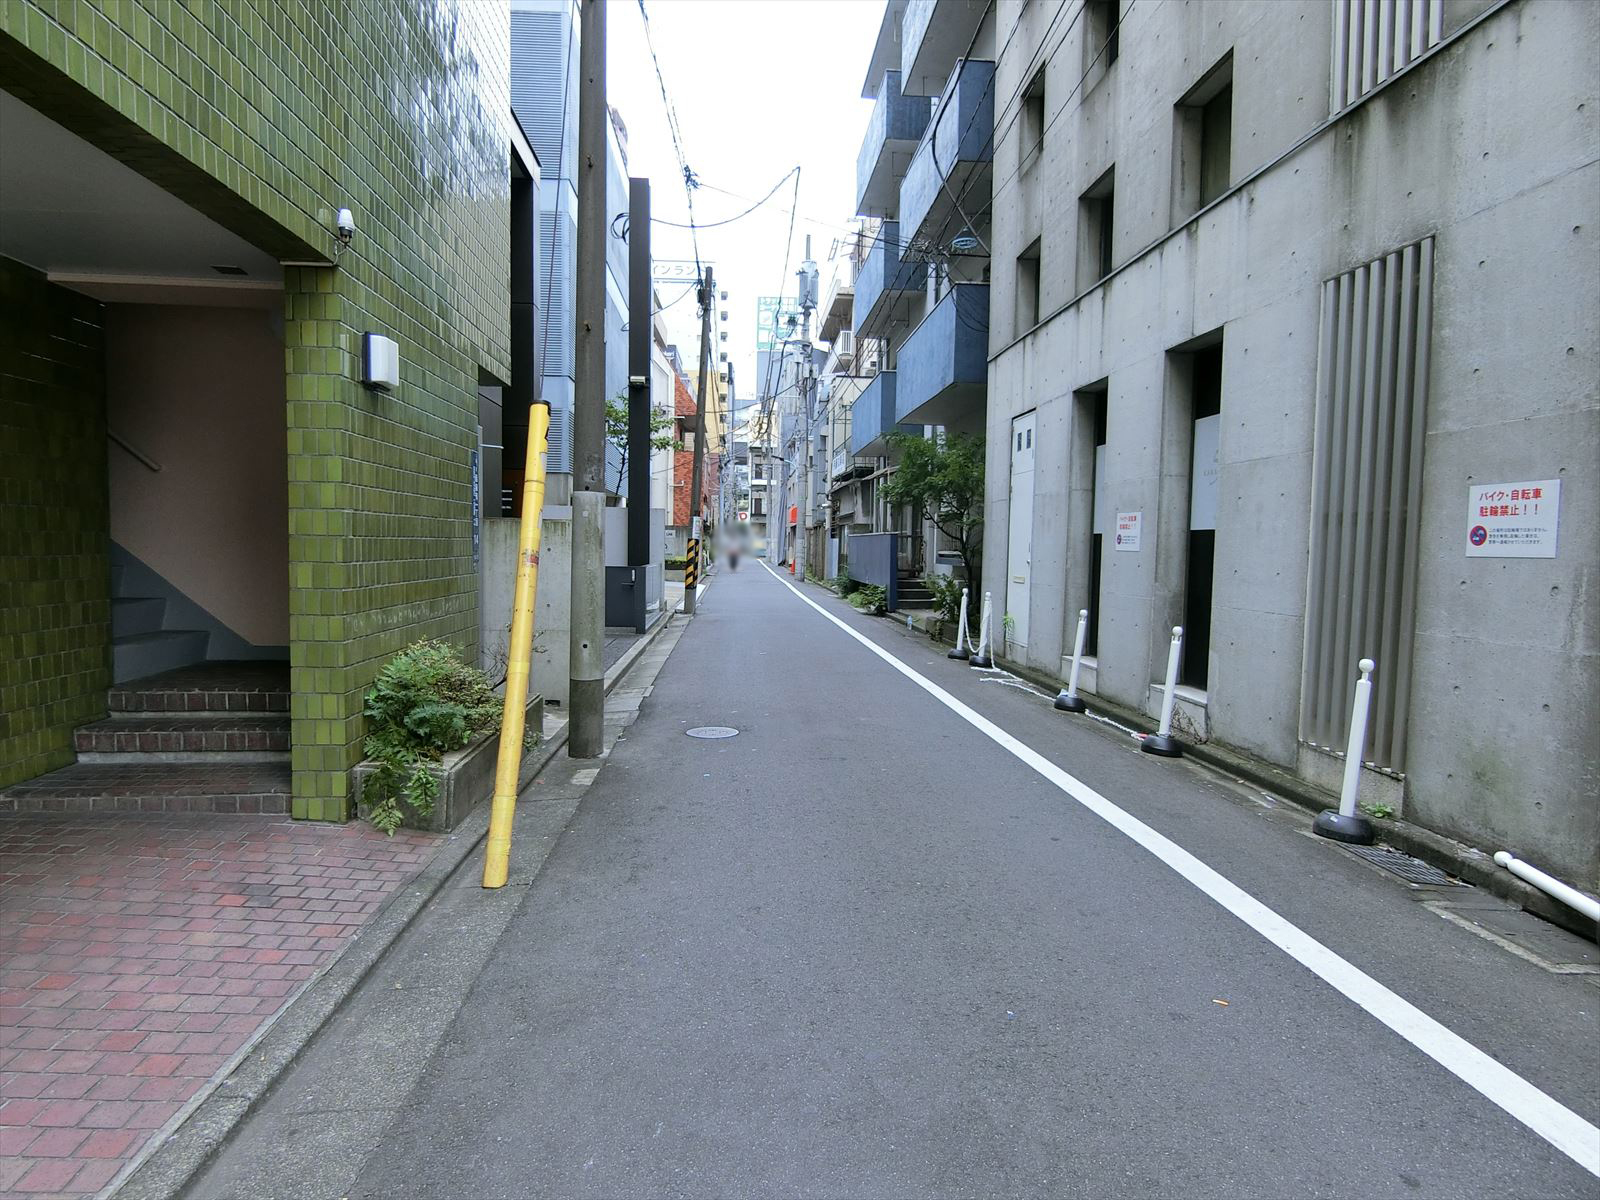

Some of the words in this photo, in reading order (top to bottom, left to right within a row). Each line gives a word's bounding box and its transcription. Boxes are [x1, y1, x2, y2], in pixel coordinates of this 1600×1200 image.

[1479, 488, 1543, 502] バイク・自転車
[1479, 503, 1539, 517] 駐輪禁止！！
